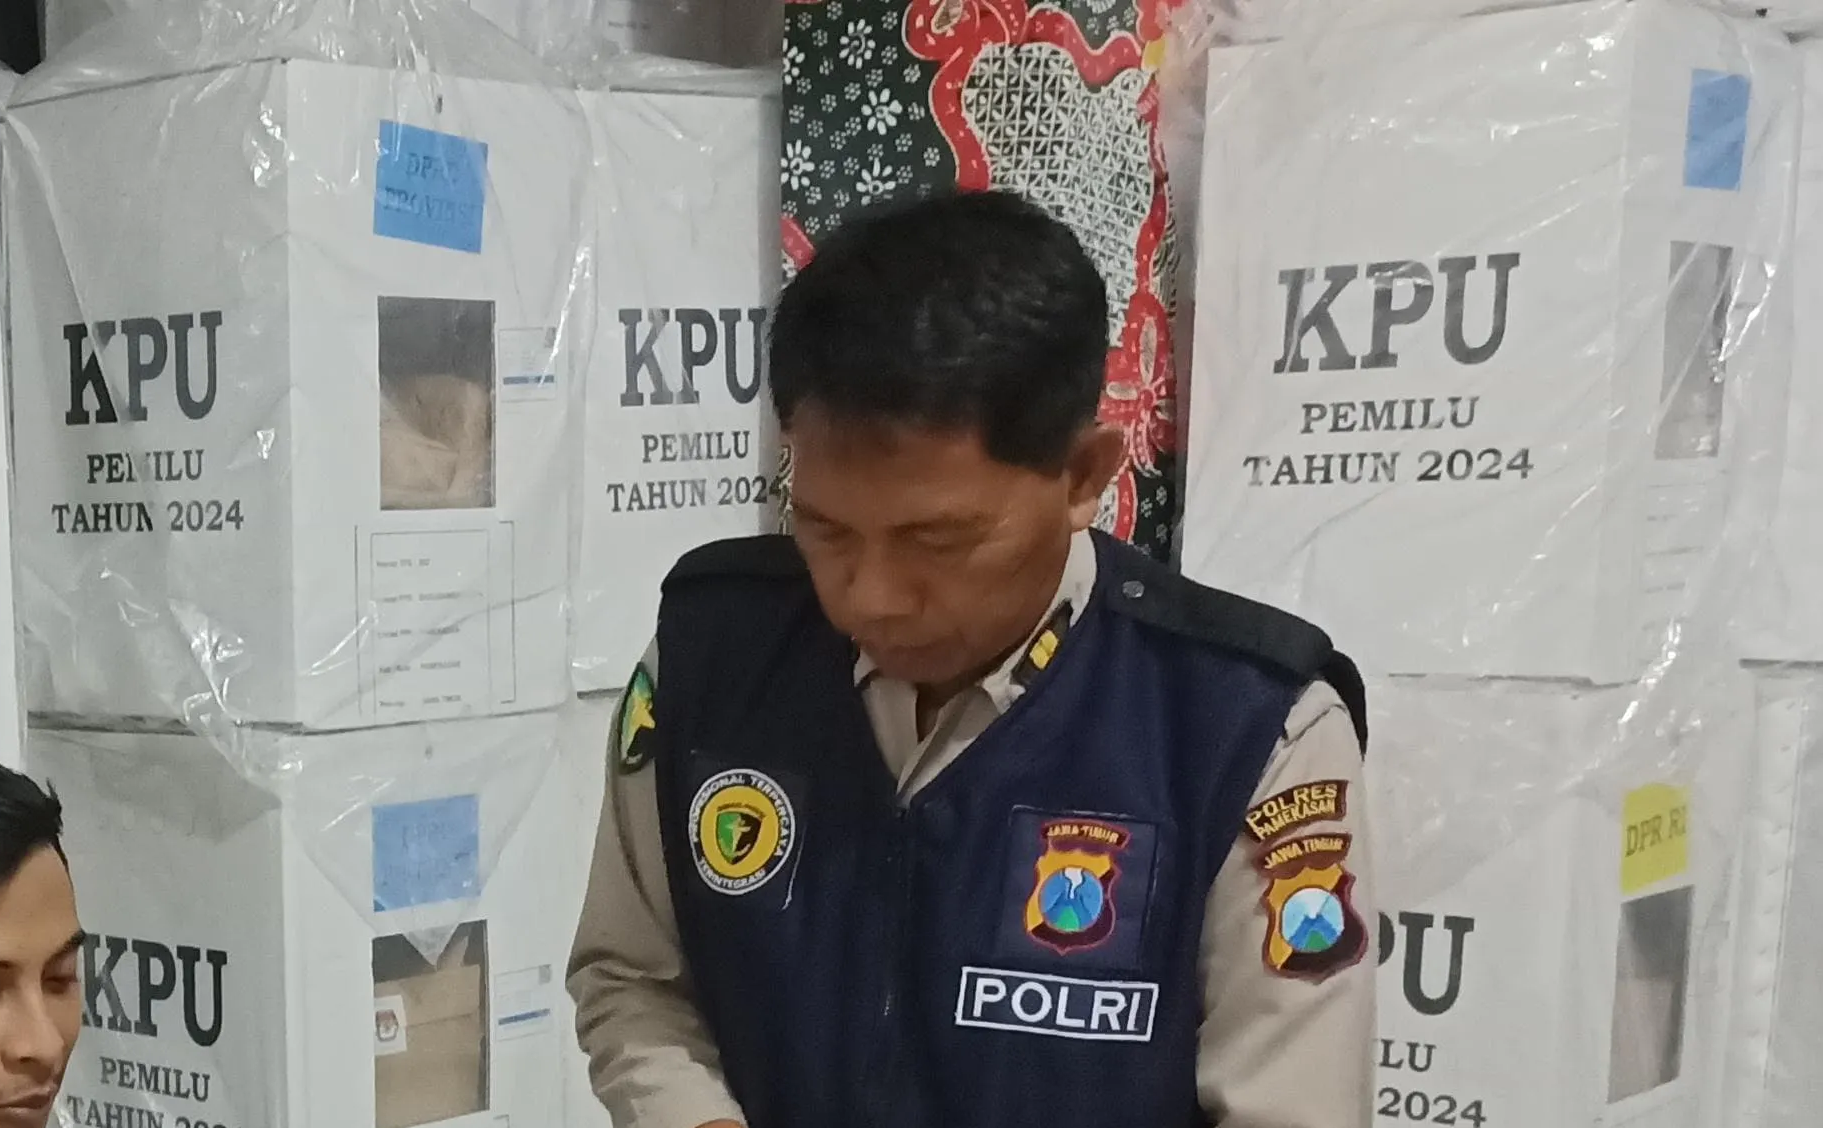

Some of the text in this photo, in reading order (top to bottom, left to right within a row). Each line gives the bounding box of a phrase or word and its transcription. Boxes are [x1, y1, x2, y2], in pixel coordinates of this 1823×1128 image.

[1274, 252, 1520, 374] KPU
[63, 311, 222, 426] KPU
[618, 308, 767, 407] KPU
[1300, 396, 1481, 434] PEMILU
[641, 431, 750, 463] PEMILU
[1244, 447, 1534, 487] TAHUN 2024
[51, 500, 244, 533] TAHUN 2024
[607, 479, 707, 513] TAHUN
[1245, 784, 1338, 831] POLRES
[1256, 798, 1336, 841] PAMEKASAN
[1047, 824, 1079, 837] JAWA
[1625, 814, 1662, 857] DPR
[1264, 842, 1303, 869] JAWA
[81, 932, 228, 1047] KPU
[972, 977, 1142, 1032] POLRI
[99, 1056, 211, 1102] PEMILU
